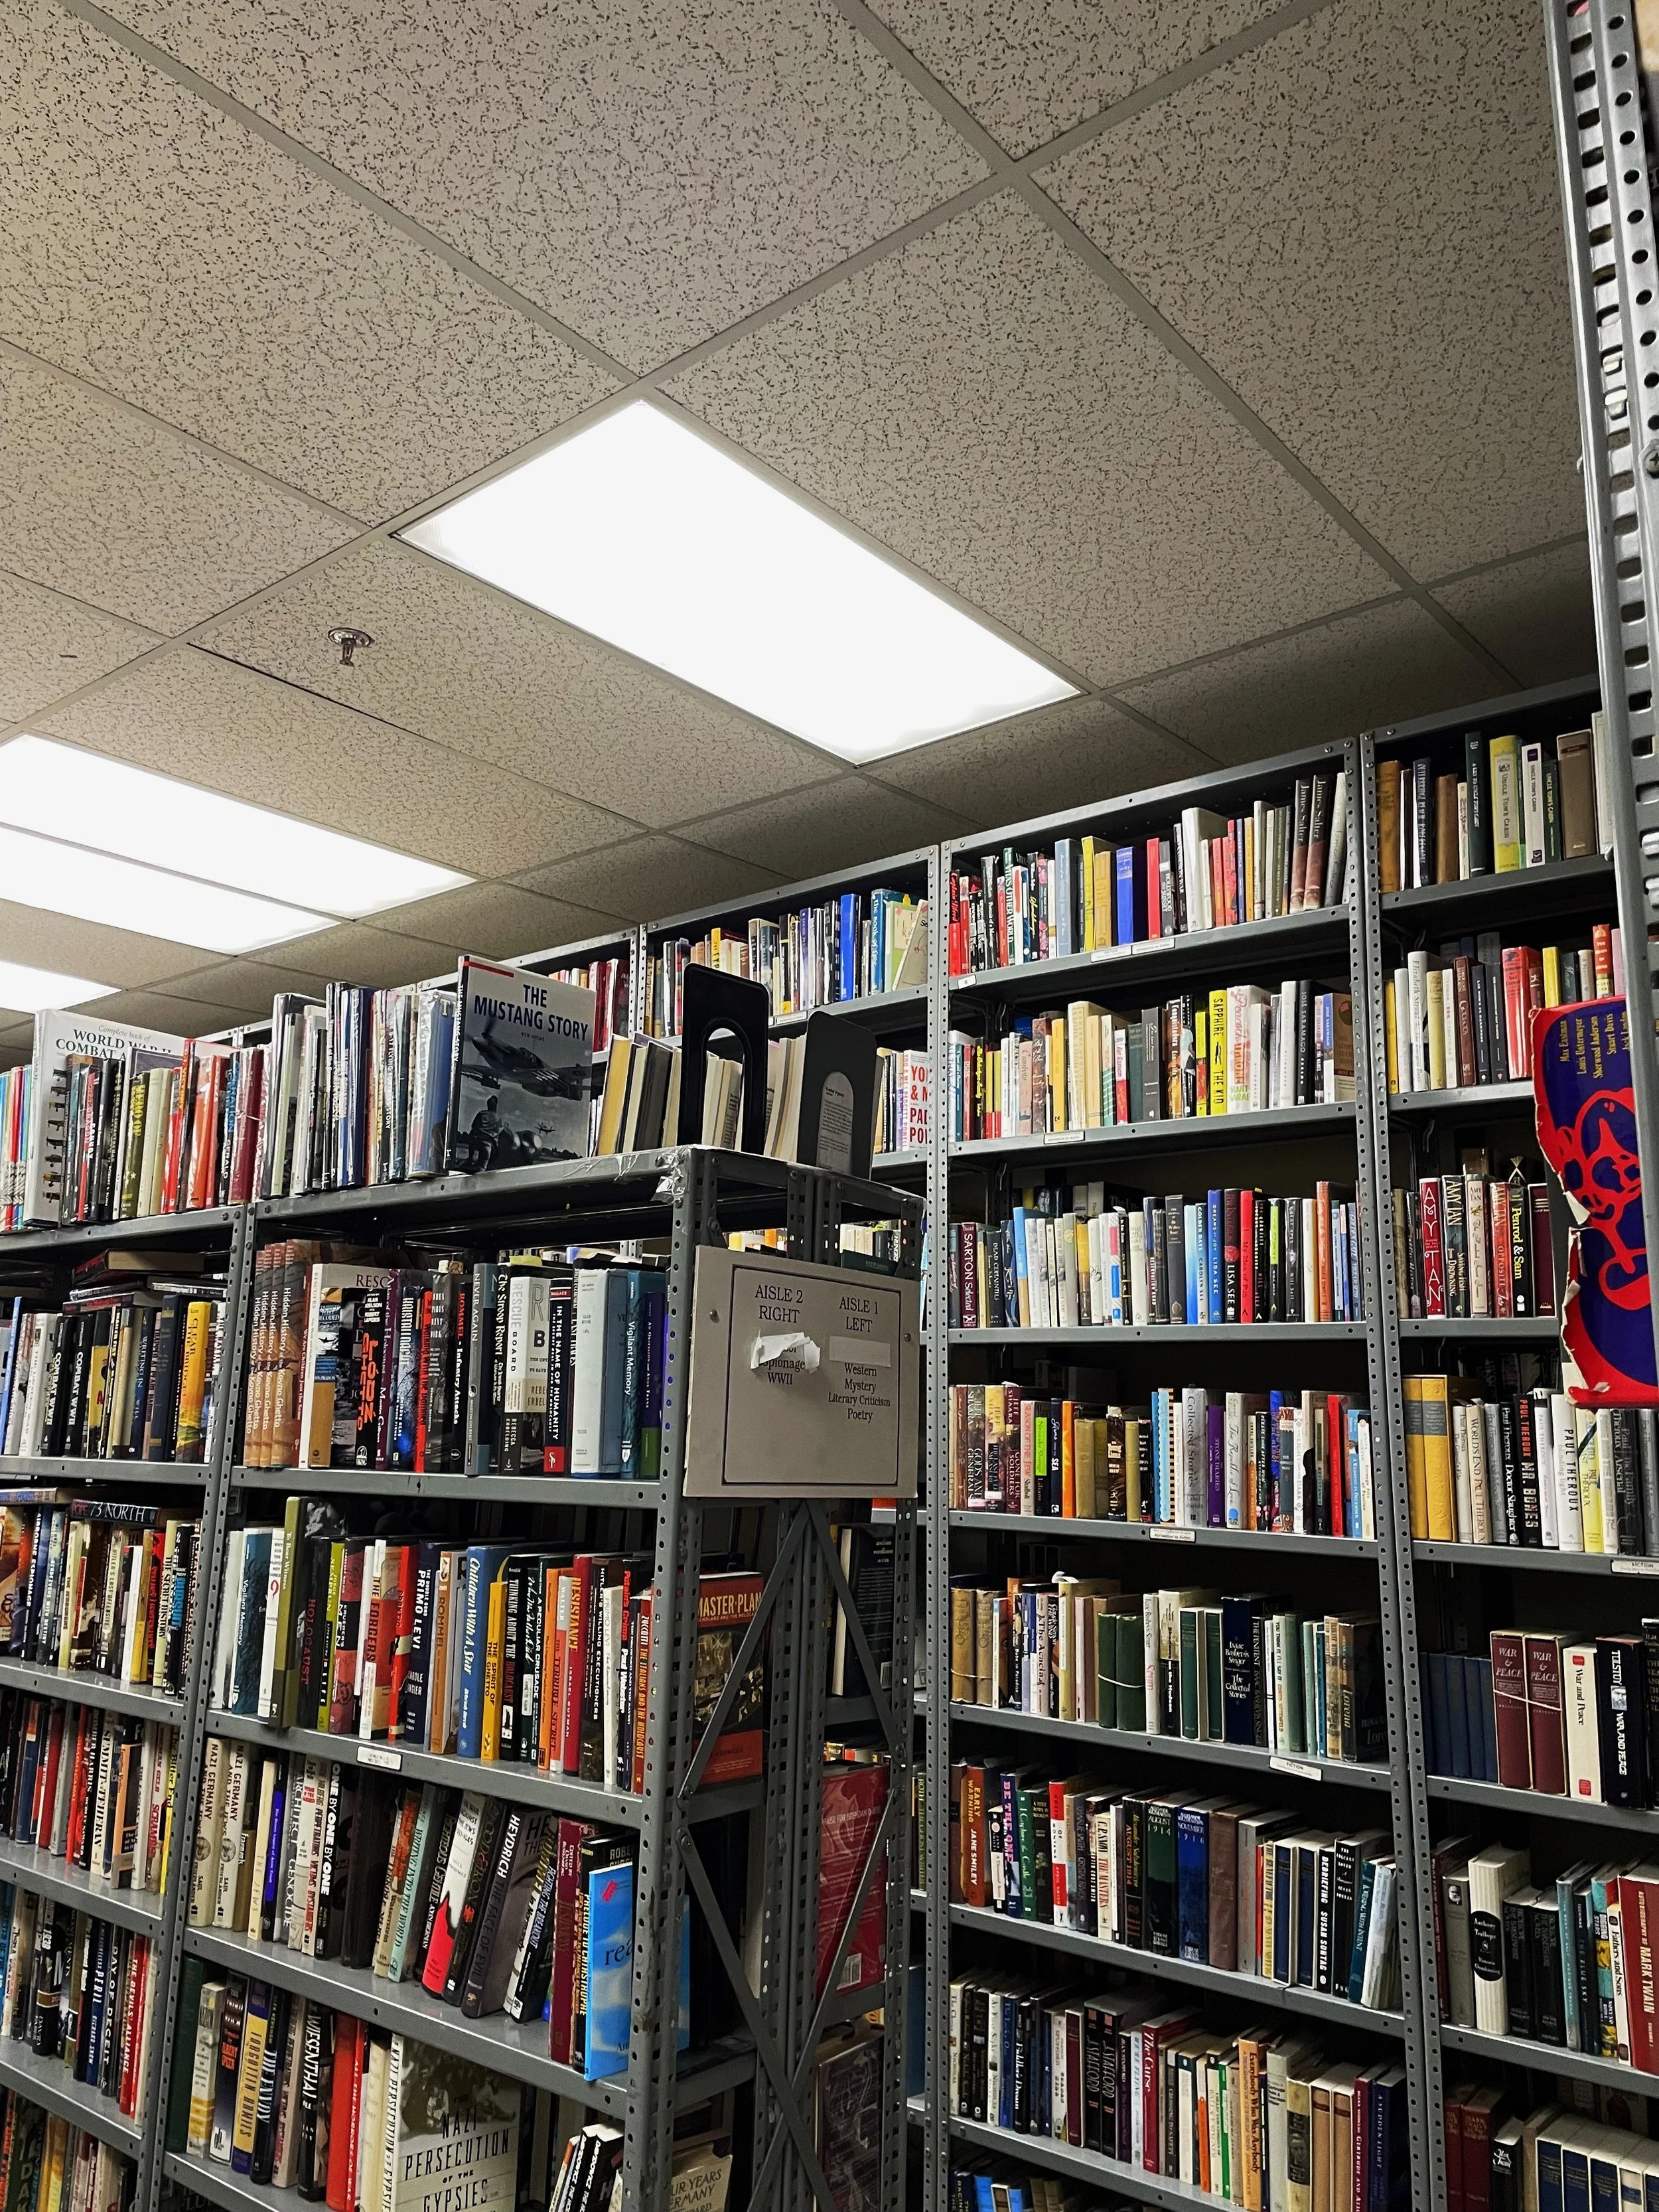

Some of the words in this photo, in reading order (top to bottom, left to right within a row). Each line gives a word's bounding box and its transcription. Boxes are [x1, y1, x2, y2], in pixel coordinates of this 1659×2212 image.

[1300, 785, 1310, 812] James
[1298, 815, 1307, 843] Salter
[523, 984, 547, 1007] THE
[99, 1025, 127, 1037] Complete
[474, 995, 543, 1029] MUSTANG
[548, 1014, 588, 1041] STORY
[1214, 999, 1224, 1037] SAPPHIRE
[56, 1039, 115, 1061] COMBAT
[74, 1029, 125, 1049] WORLD
[1214, 1070, 1224, 1086] THE
[1213, 1089, 1224, 1104] KID
[1445, 1180, 1463, 1205] AMY
[1423, 1187, 1438, 1237] AMY
[1447, 1206, 1463, 1226] TAN
[1512, 1207, 1524, 1244] Penrod
[964, 1233, 974, 1280] SARTON
[1513, 1245, 1524, 1255] &
[498, 1274, 508, 1290] The
[1424, 1250, 1445, 1307] TAN
[1514, 1256, 1524, 1280] Sam
[282, 1288, 291, 1317] Hidden
[496, 1294, 506, 1322] Stroop
[512, 1283, 523, 1328] RESCUE
[755, 1285, 792, 1303] AISLE
[796, 1290, 803, 1303] 2
[839, 1296, 871, 1313] AISLE
[875, 1303, 878, 1314] 1
[965, 1282, 974, 1311] Selected
[557, 1306, 563, 1315] IN
[758, 1305, 800, 1323] RIGHT
[845, 1317, 873, 1333] LEFT
[250, 1329, 259, 1359] History
[279, 1320, 289, 1351] History
[495, 1325, 505, 1355] Report
[276, 1369, 285, 1396] Kovno
[357, 1333, 370, 1431] GHETTO
[454, 1348, 463, 1388] Infantry
[555, 1370, 561, 1384] OF
[767, 1372, 792, 1384] WWII
[845, 1364, 877, 1377] Western
[829, 1393, 857, 1406] Literary
[859, 1396, 891, 1407] Criticism
[845, 1378, 876, 1393] Mystery
[274, 1398, 283, 1428] Ghetto
[847, 1409, 873, 1424] Poetry
[1187, 1396, 1195, 1447] Collected
[1564, 1429, 1575, 1455] PAUL
[1566, 1461, 1579, 1511] THEROUX
[31, 1513, 41, 1556] AIRBORNE
[27, 1558, 36, 1607] ESPIONAGE
[415, 1570, 426, 1614] PRIMO
[508, 1580, 519, 1613] THINKING
[366, 1602, 380, 1662] FORGERS
[412, 1619, 422, 1649] LEVI
[437, 1597, 445, 1648] ROMMEL
[507, 1617, 517, 1641] ABOUT
[641, 1615, 650, 1645] ZUCCOTTI
[301, 1597, 317, 1686] HOLOCAUST
[506, 1642, 516, 1659] THE
[1498, 1647, 1518, 1657] WAR
[1533, 1651, 1552, 1661] WAR
[640, 1649, 648, 1664] THE
[504, 1661, 515, 1704] HOLOCAUST
[593, 1649, 602, 1720] EXECUTIONERS
[638, 1665, 647, 1692] ITALIANS
[1496, 1667, 1523, 1677] PEACE
[1530, 1671, 1558, 1682] PEACE
[490, 1692, 494, 1706] OF
[636, 1707, 646, 1720] THE
[637, 1694, 646, 1706] AND
[1342, 1690, 1353, 1728] Lorena
[635, 1720, 645, 1759] HOLOCAUST
[210, 1744, 218, 1766] NAZI
[235, 1745, 244, 1769] NAZI
[329, 1763, 340, 1796] ONE
[1003, 1781, 1011, 1799] BE
[204, 1772, 215, 1820] GERMANY
[230, 1774, 242, 1821] GERMANY
[291, 1773, 305, 1843] ARCHITECT
[328, 1798, 337, 1812] BY
[325, 1812, 336, 1846] ONE
[1148, 1824, 1171, 1836] 1914
[325, 1846, 333, 1863] BY
[283, 1858, 296, 1927] GENOCIDE
[321, 1864, 332, 1895] ONE
[1321, 1856, 1329, 1905] DEBRIEFING
[1319, 1939, 1327, 1971] SONTAG
[1640, 1947, 1652, 1977] MARK
[94, 1969, 104, 2004] PERIL
[108, 1980, 115, 2002] OF
[1641, 1979, 1654, 2014] TWAIN
[103, 2008, 113, 2065] DECEIT
[303, 2015, 321, 2099] WIESENTHAL
[442, 2106, 477, 2139] NAZI
[405, 2128, 509, 2181] PERSECUTION
[459, 2170, 474, 2178] THE
[424, 2179, 488, 2212] GYPSIES
